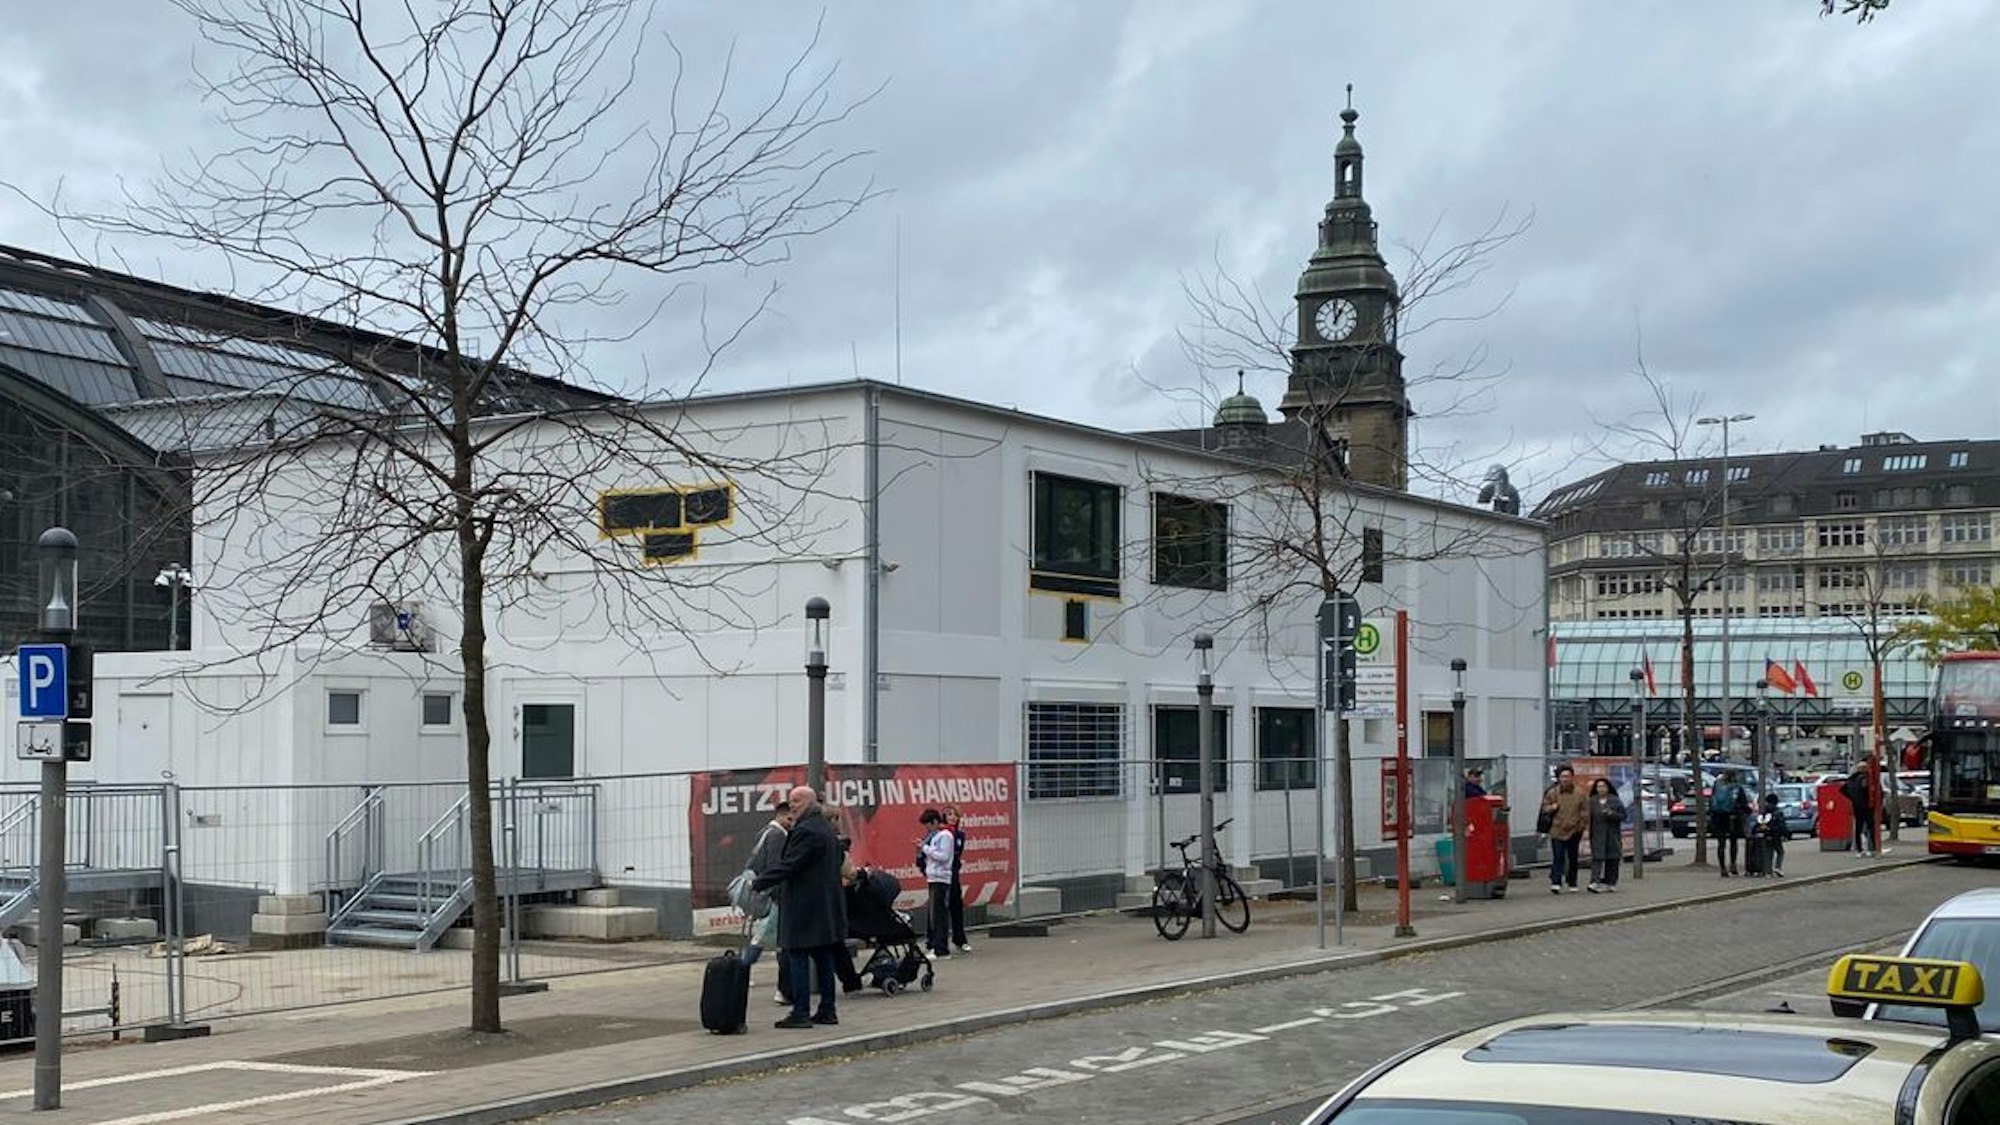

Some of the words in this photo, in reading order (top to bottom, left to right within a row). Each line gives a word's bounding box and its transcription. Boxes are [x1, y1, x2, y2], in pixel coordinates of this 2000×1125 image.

[1359, 630, 1372, 648] H
[29, 655, 55, 709] P
[702, 783, 794, 815] JETZT
[825, 779, 876, 807] UCH
[879, 779, 906, 805] IN
[908, 777, 1008, 804] HAMBURG
[960, 813, 1010, 827] rkehrstechnik
[1853, 963, 1954, 996] TAXI
[786, 988, 1466, 1125] BEREICH
